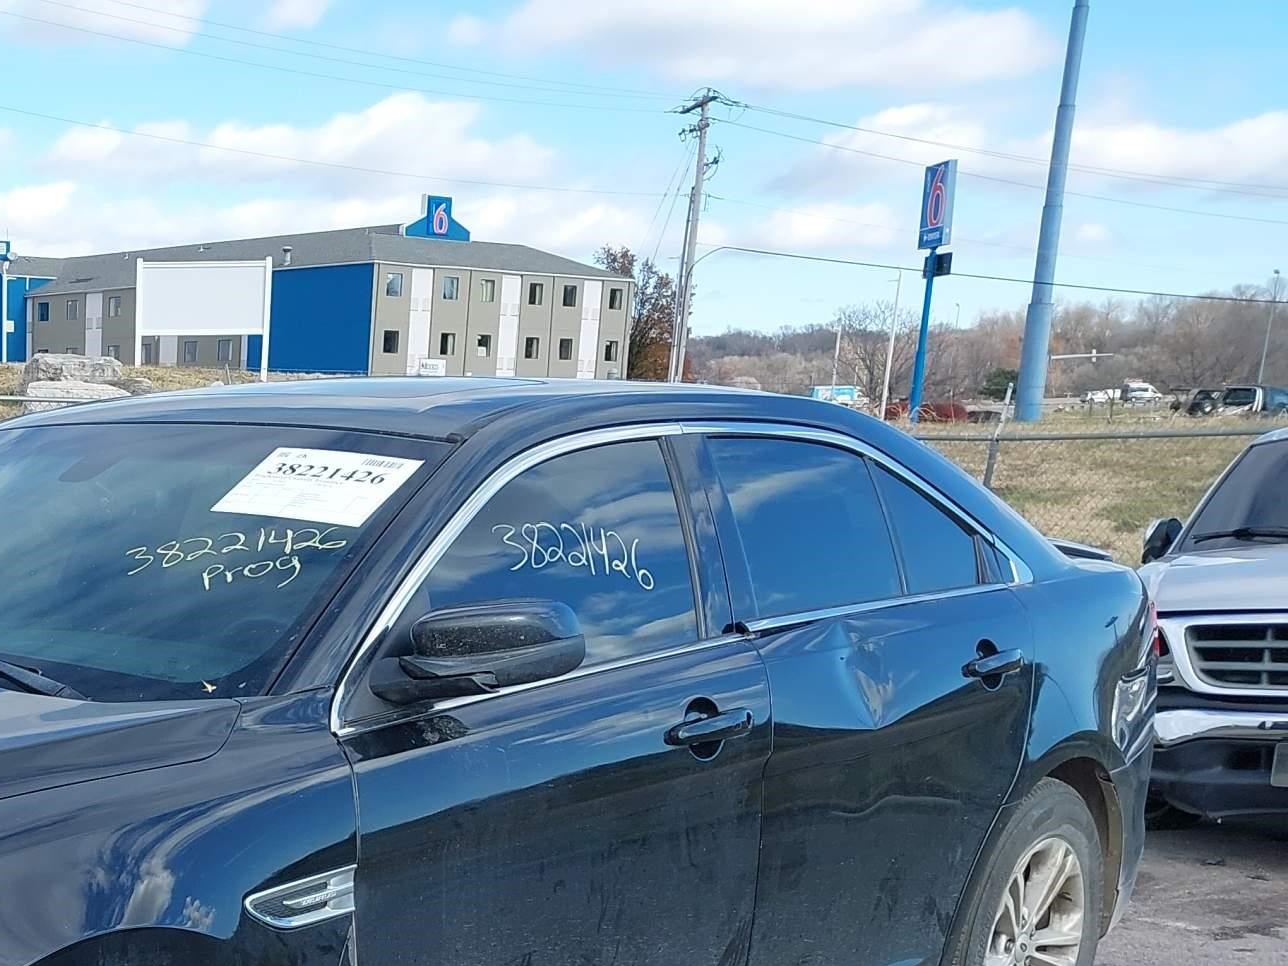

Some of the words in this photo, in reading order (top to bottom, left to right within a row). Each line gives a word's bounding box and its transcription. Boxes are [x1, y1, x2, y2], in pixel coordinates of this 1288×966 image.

[433, 203, 449, 234] 6
[926, 164, 946, 228] 6
[267, 462, 389, 485] 38221426
[125, 527, 348, 576] 38221426
[491, 521, 655, 590] 38221426
